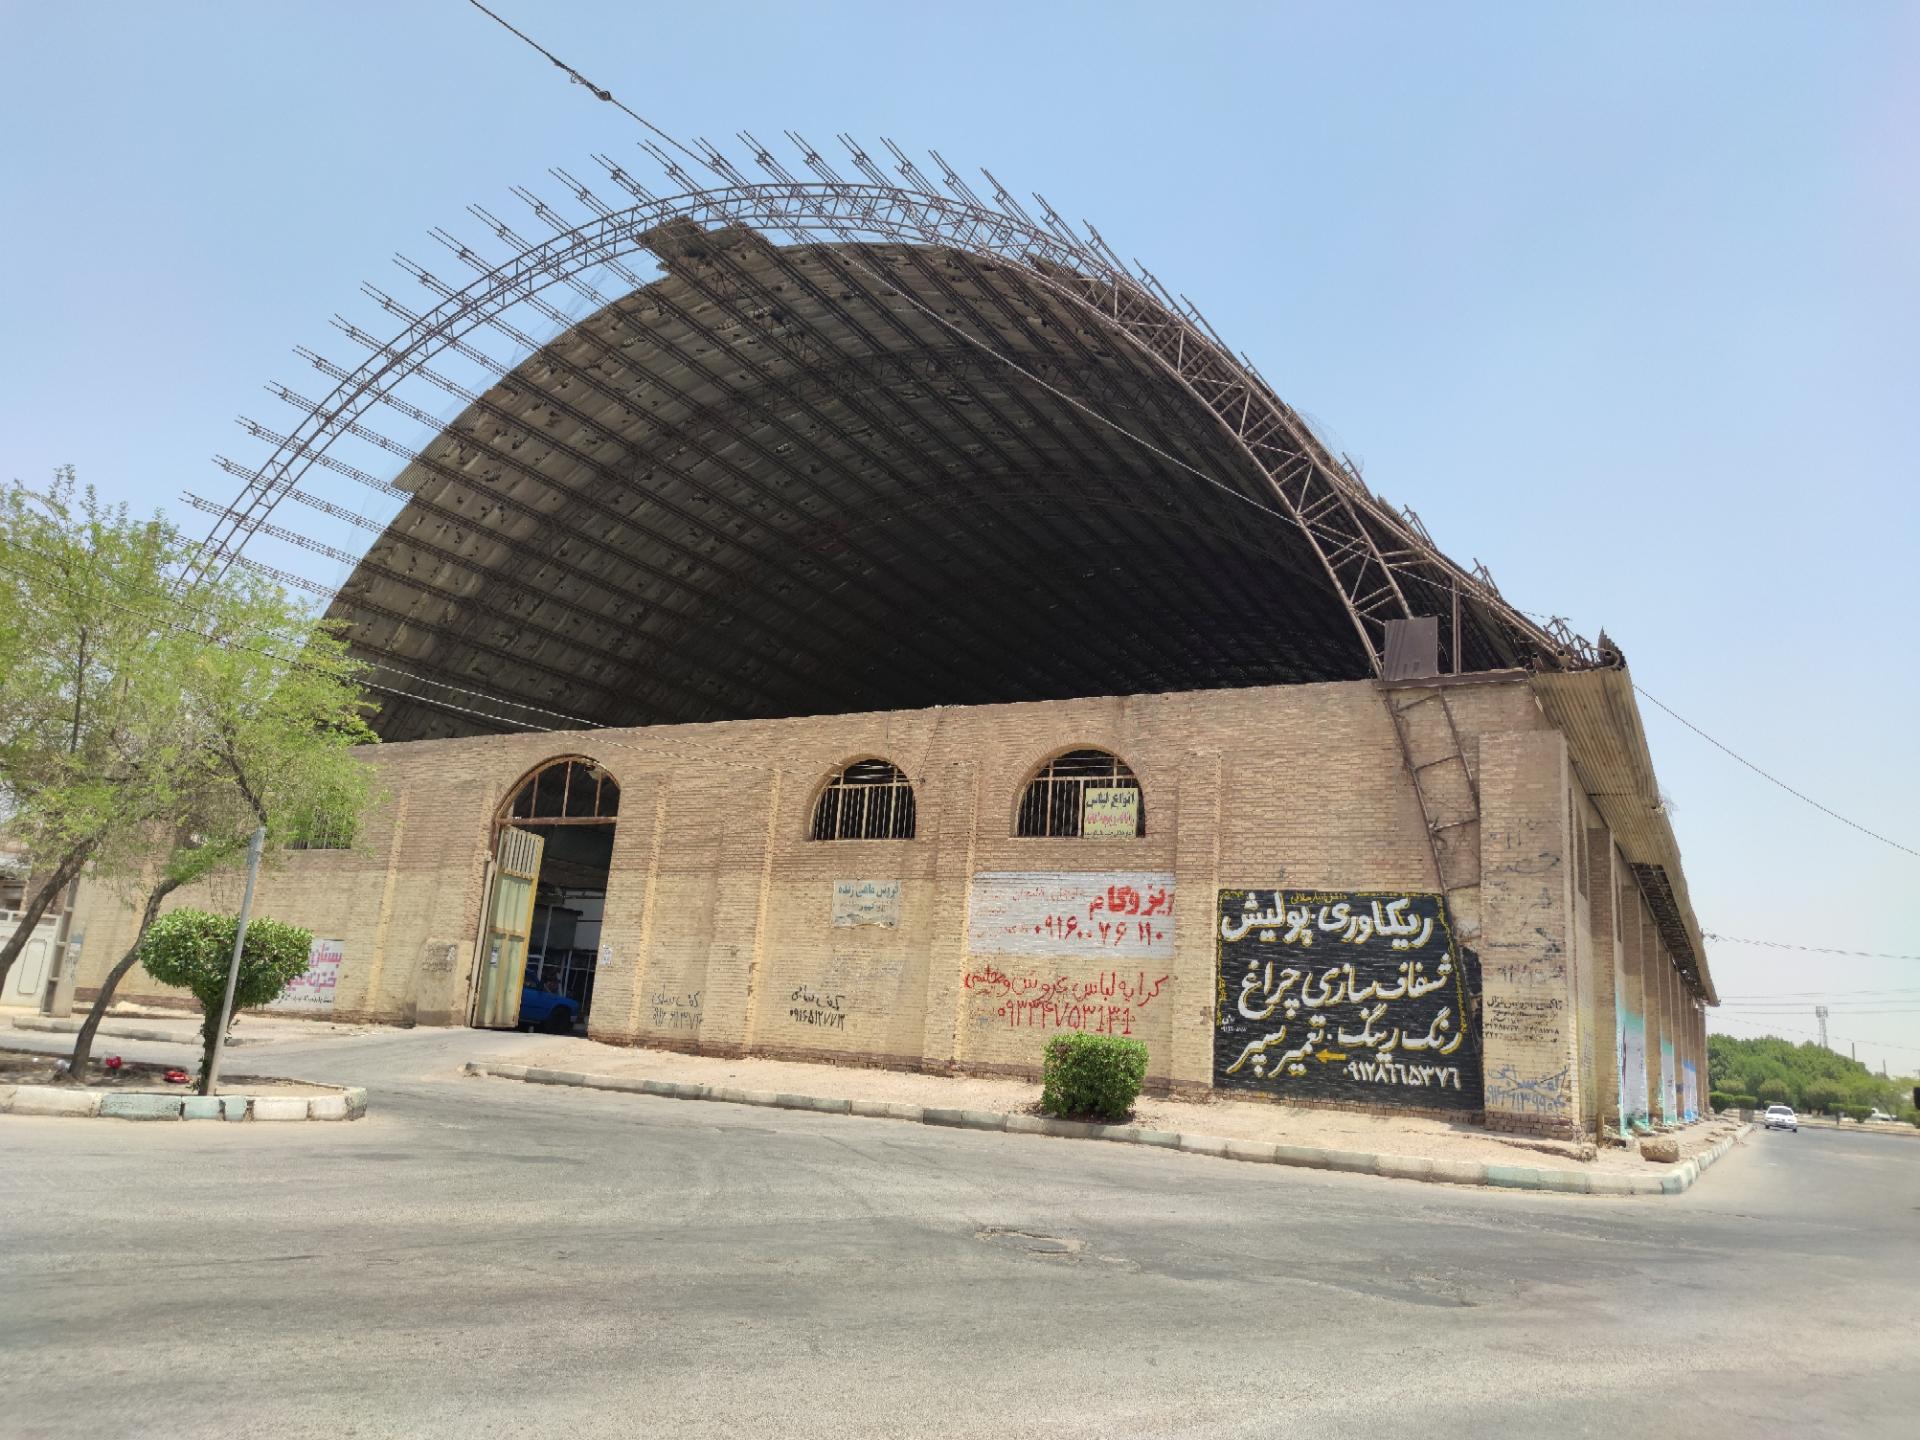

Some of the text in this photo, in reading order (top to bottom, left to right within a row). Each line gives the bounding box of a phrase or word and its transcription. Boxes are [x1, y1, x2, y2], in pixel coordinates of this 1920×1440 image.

[1221, 891, 1434, 950] ریکاوری پولیش
[1237, 959, 1302, 1021] چراغ
[1225, 1024, 1288, 1078] سپر
[1268, 1014, 1328, 1079] تعمیر
[1402, 1006, 1463, 1055] رنگ
